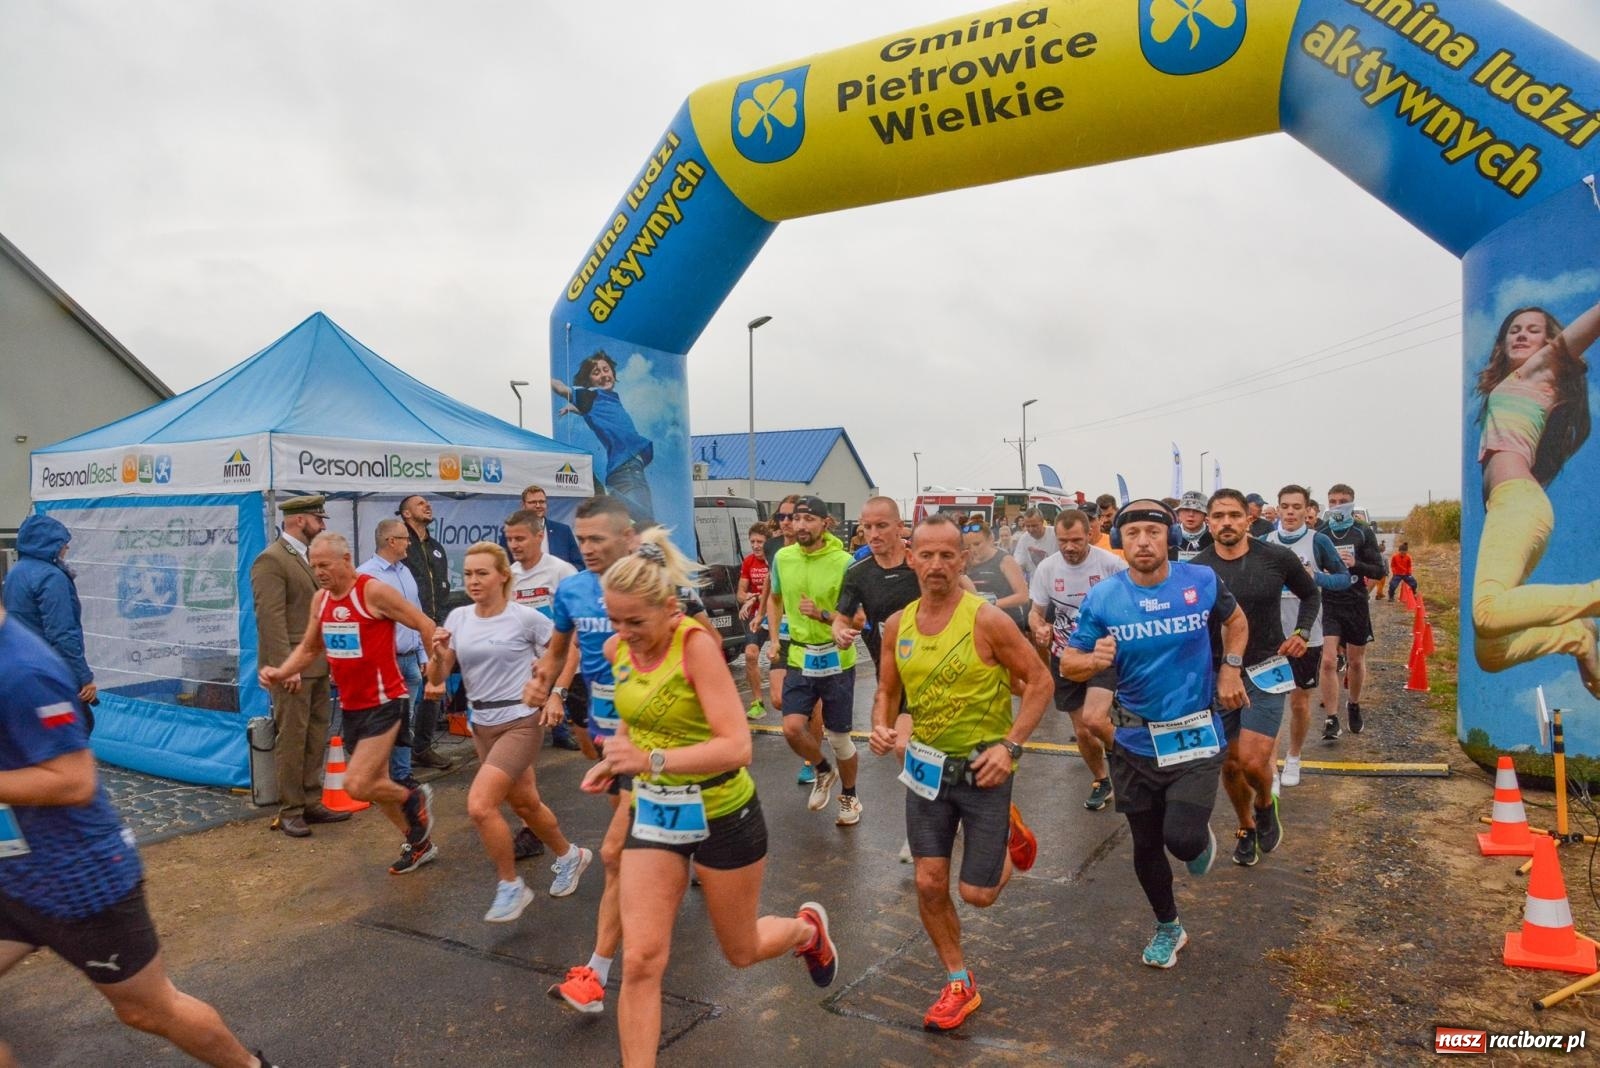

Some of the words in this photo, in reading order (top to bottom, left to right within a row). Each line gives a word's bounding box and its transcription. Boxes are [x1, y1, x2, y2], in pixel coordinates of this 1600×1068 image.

[880, 7, 1050, 63] Gmina
[838, 30, 1098, 113] Pietrowice
[1344, 0, 1477, 69] mina
[1471, 49, 1600, 148] ludzi
[868, 81, 1064, 145] Wielkie
[1301, 20, 1542, 198] aktywnych
[566, 211, 628, 302] Gmina
[626, 129, 681, 212] ludzi
[588, 158, 706, 324] aktywnych
[42, 464, 117, 488] PersonalBest
[223, 463, 251, 478] MITKO
[298, 450, 432, 478] PersonalBest
[555, 473, 579, 485] MITKO
[1107, 609, 1211, 642] RUNNERS
[330, 634, 347, 649] 65
[811, 655, 828, 669] 45
[1272, 668, 1284, 683] 3
[1173, 728, 1201, 751] 13
[652, 804, 681, 829] 37
